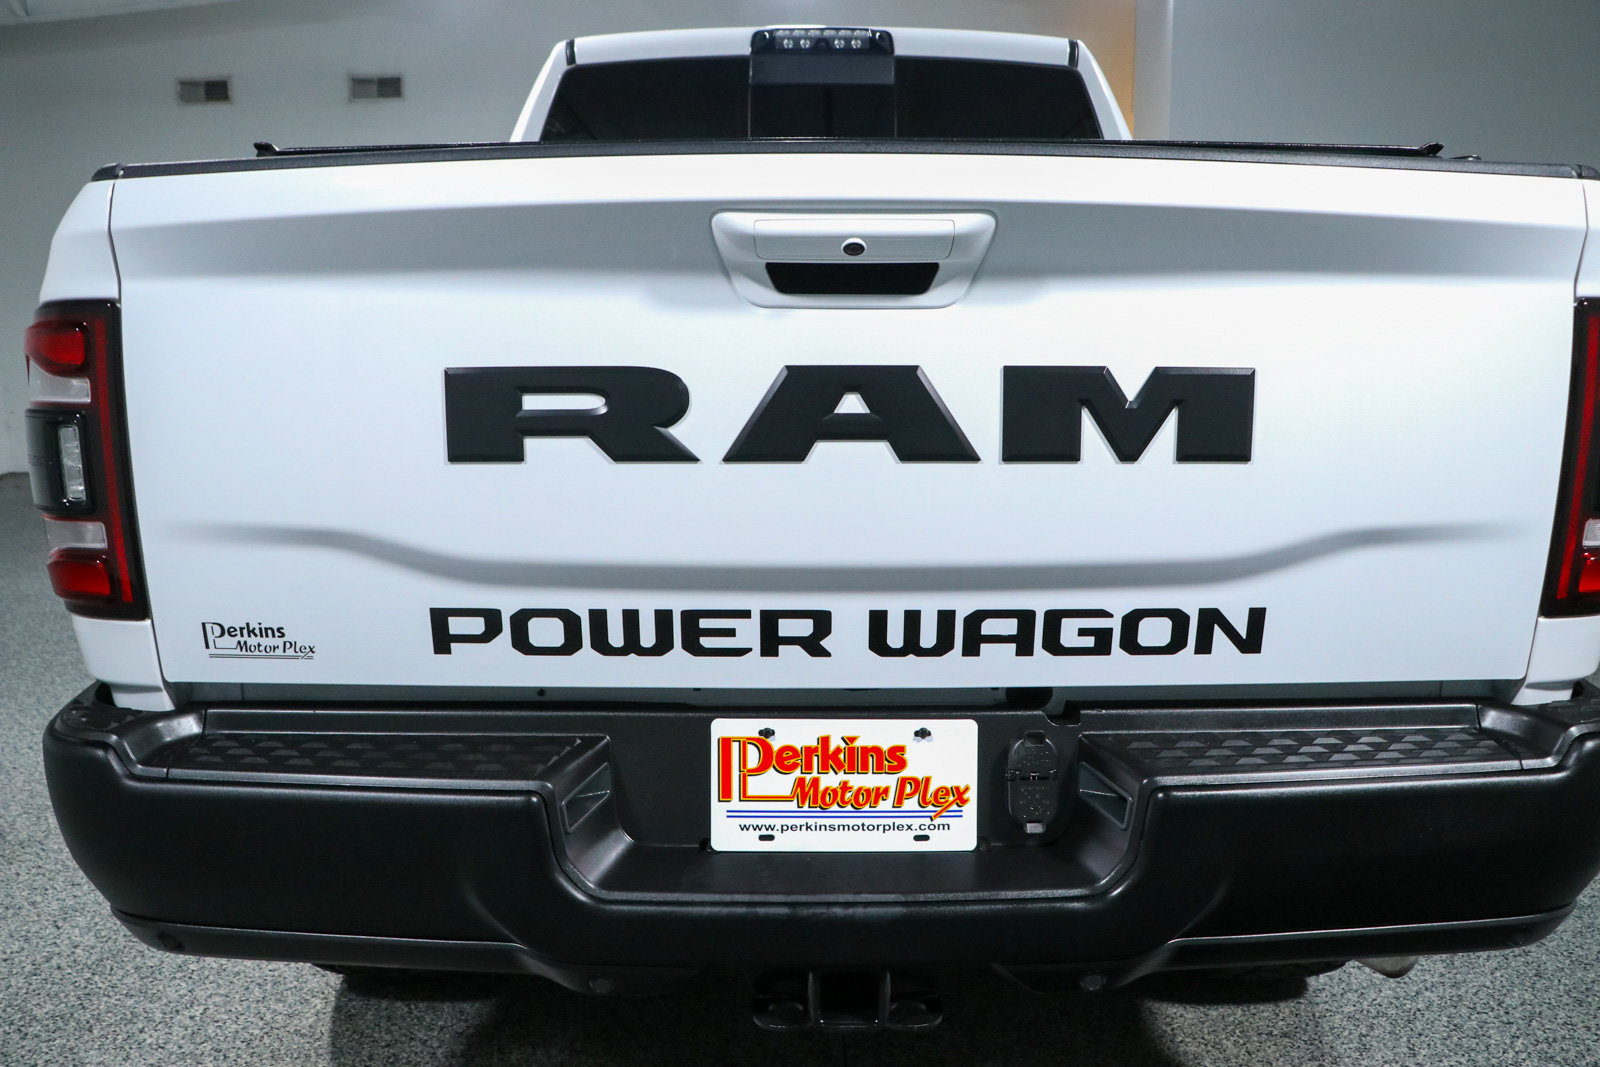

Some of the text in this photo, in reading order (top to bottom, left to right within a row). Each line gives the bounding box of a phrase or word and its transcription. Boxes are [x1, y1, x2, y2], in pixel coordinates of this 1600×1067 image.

[445, 365, 1255, 463] RAM
[201, 622, 285, 650] Perkins
[236, 640, 315, 658] Motor Plex
[429, 607, 1266, 657] POWER WAGON
[718, 734, 908, 801] Perkins
[790, 775, 971, 820] Motor Plex
[738, 820, 951, 833] www.perkinsmotorplex.com
